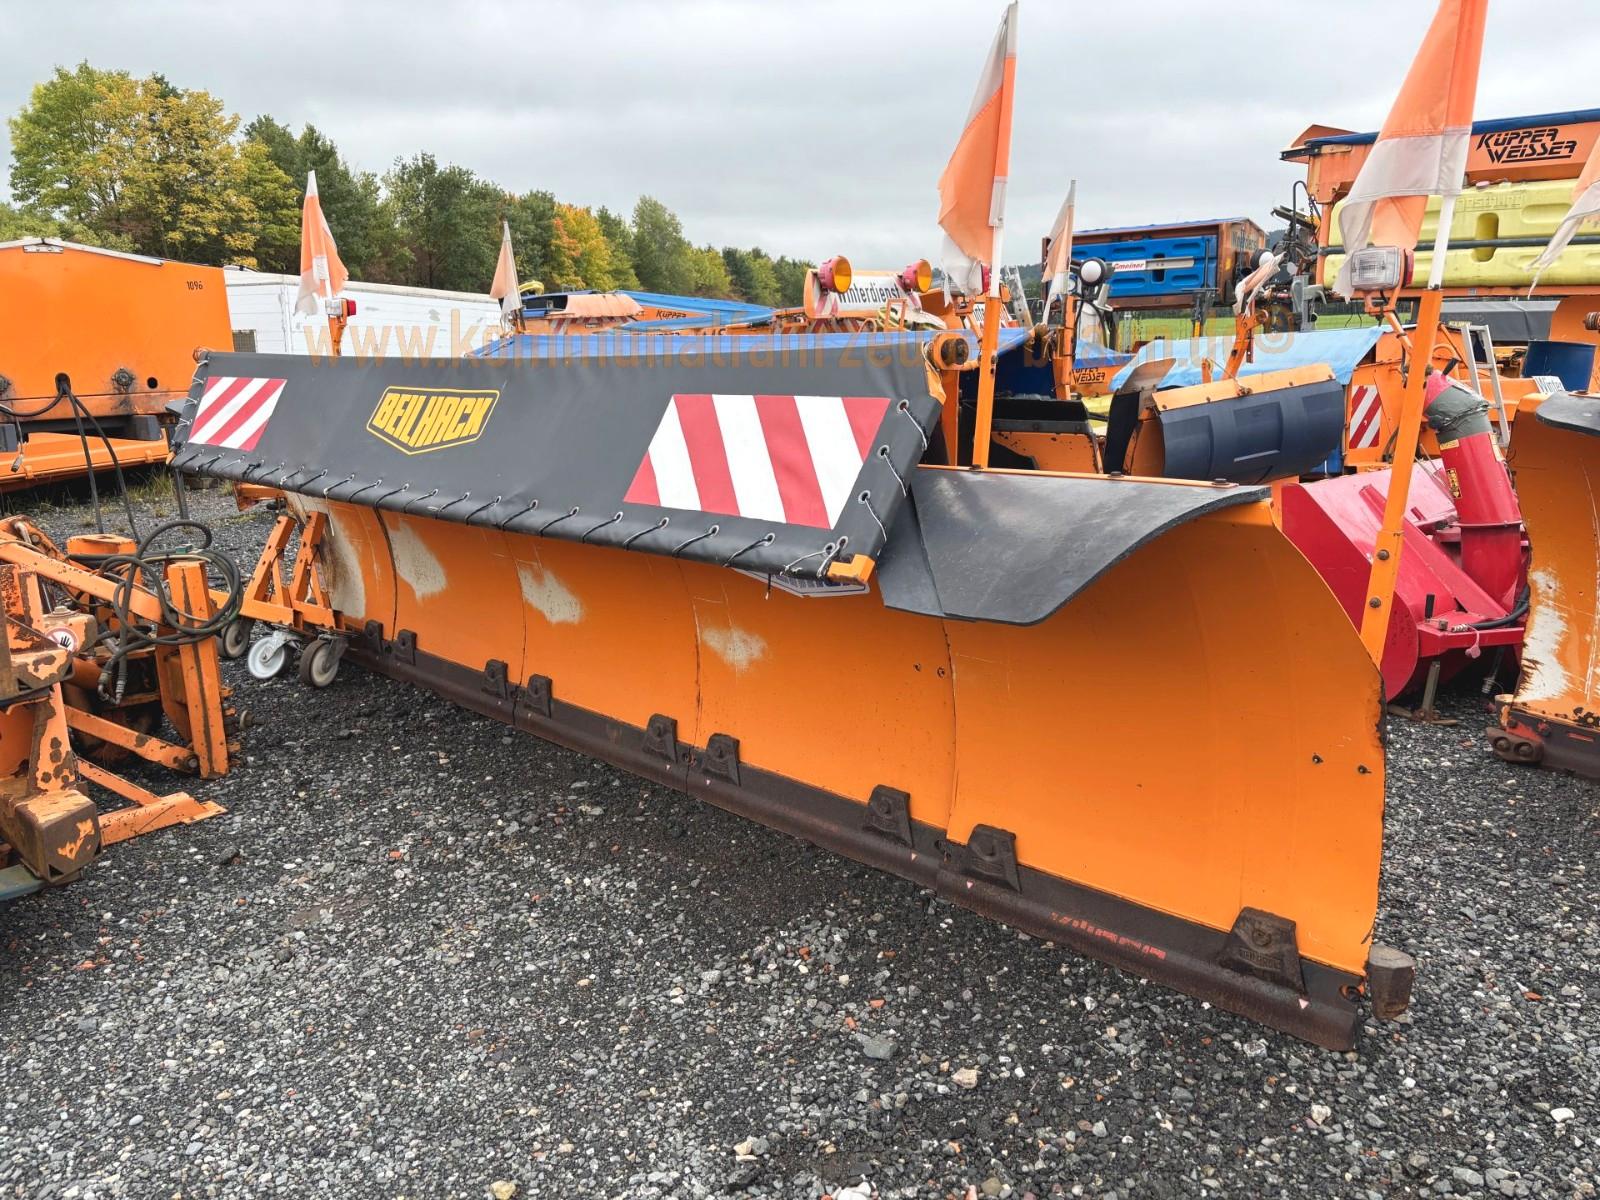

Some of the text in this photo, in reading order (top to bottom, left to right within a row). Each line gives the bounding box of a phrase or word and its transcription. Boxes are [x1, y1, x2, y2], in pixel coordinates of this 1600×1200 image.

[1476, 127, 1559, 152] KÜPPER
[1487, 140, 1578, 164] WEISSER
[1113, 262, 1145, 270] Gmeiner
[186, 280, 203, 290] 1096
[371, 392, 494, 449] BEILHACK
